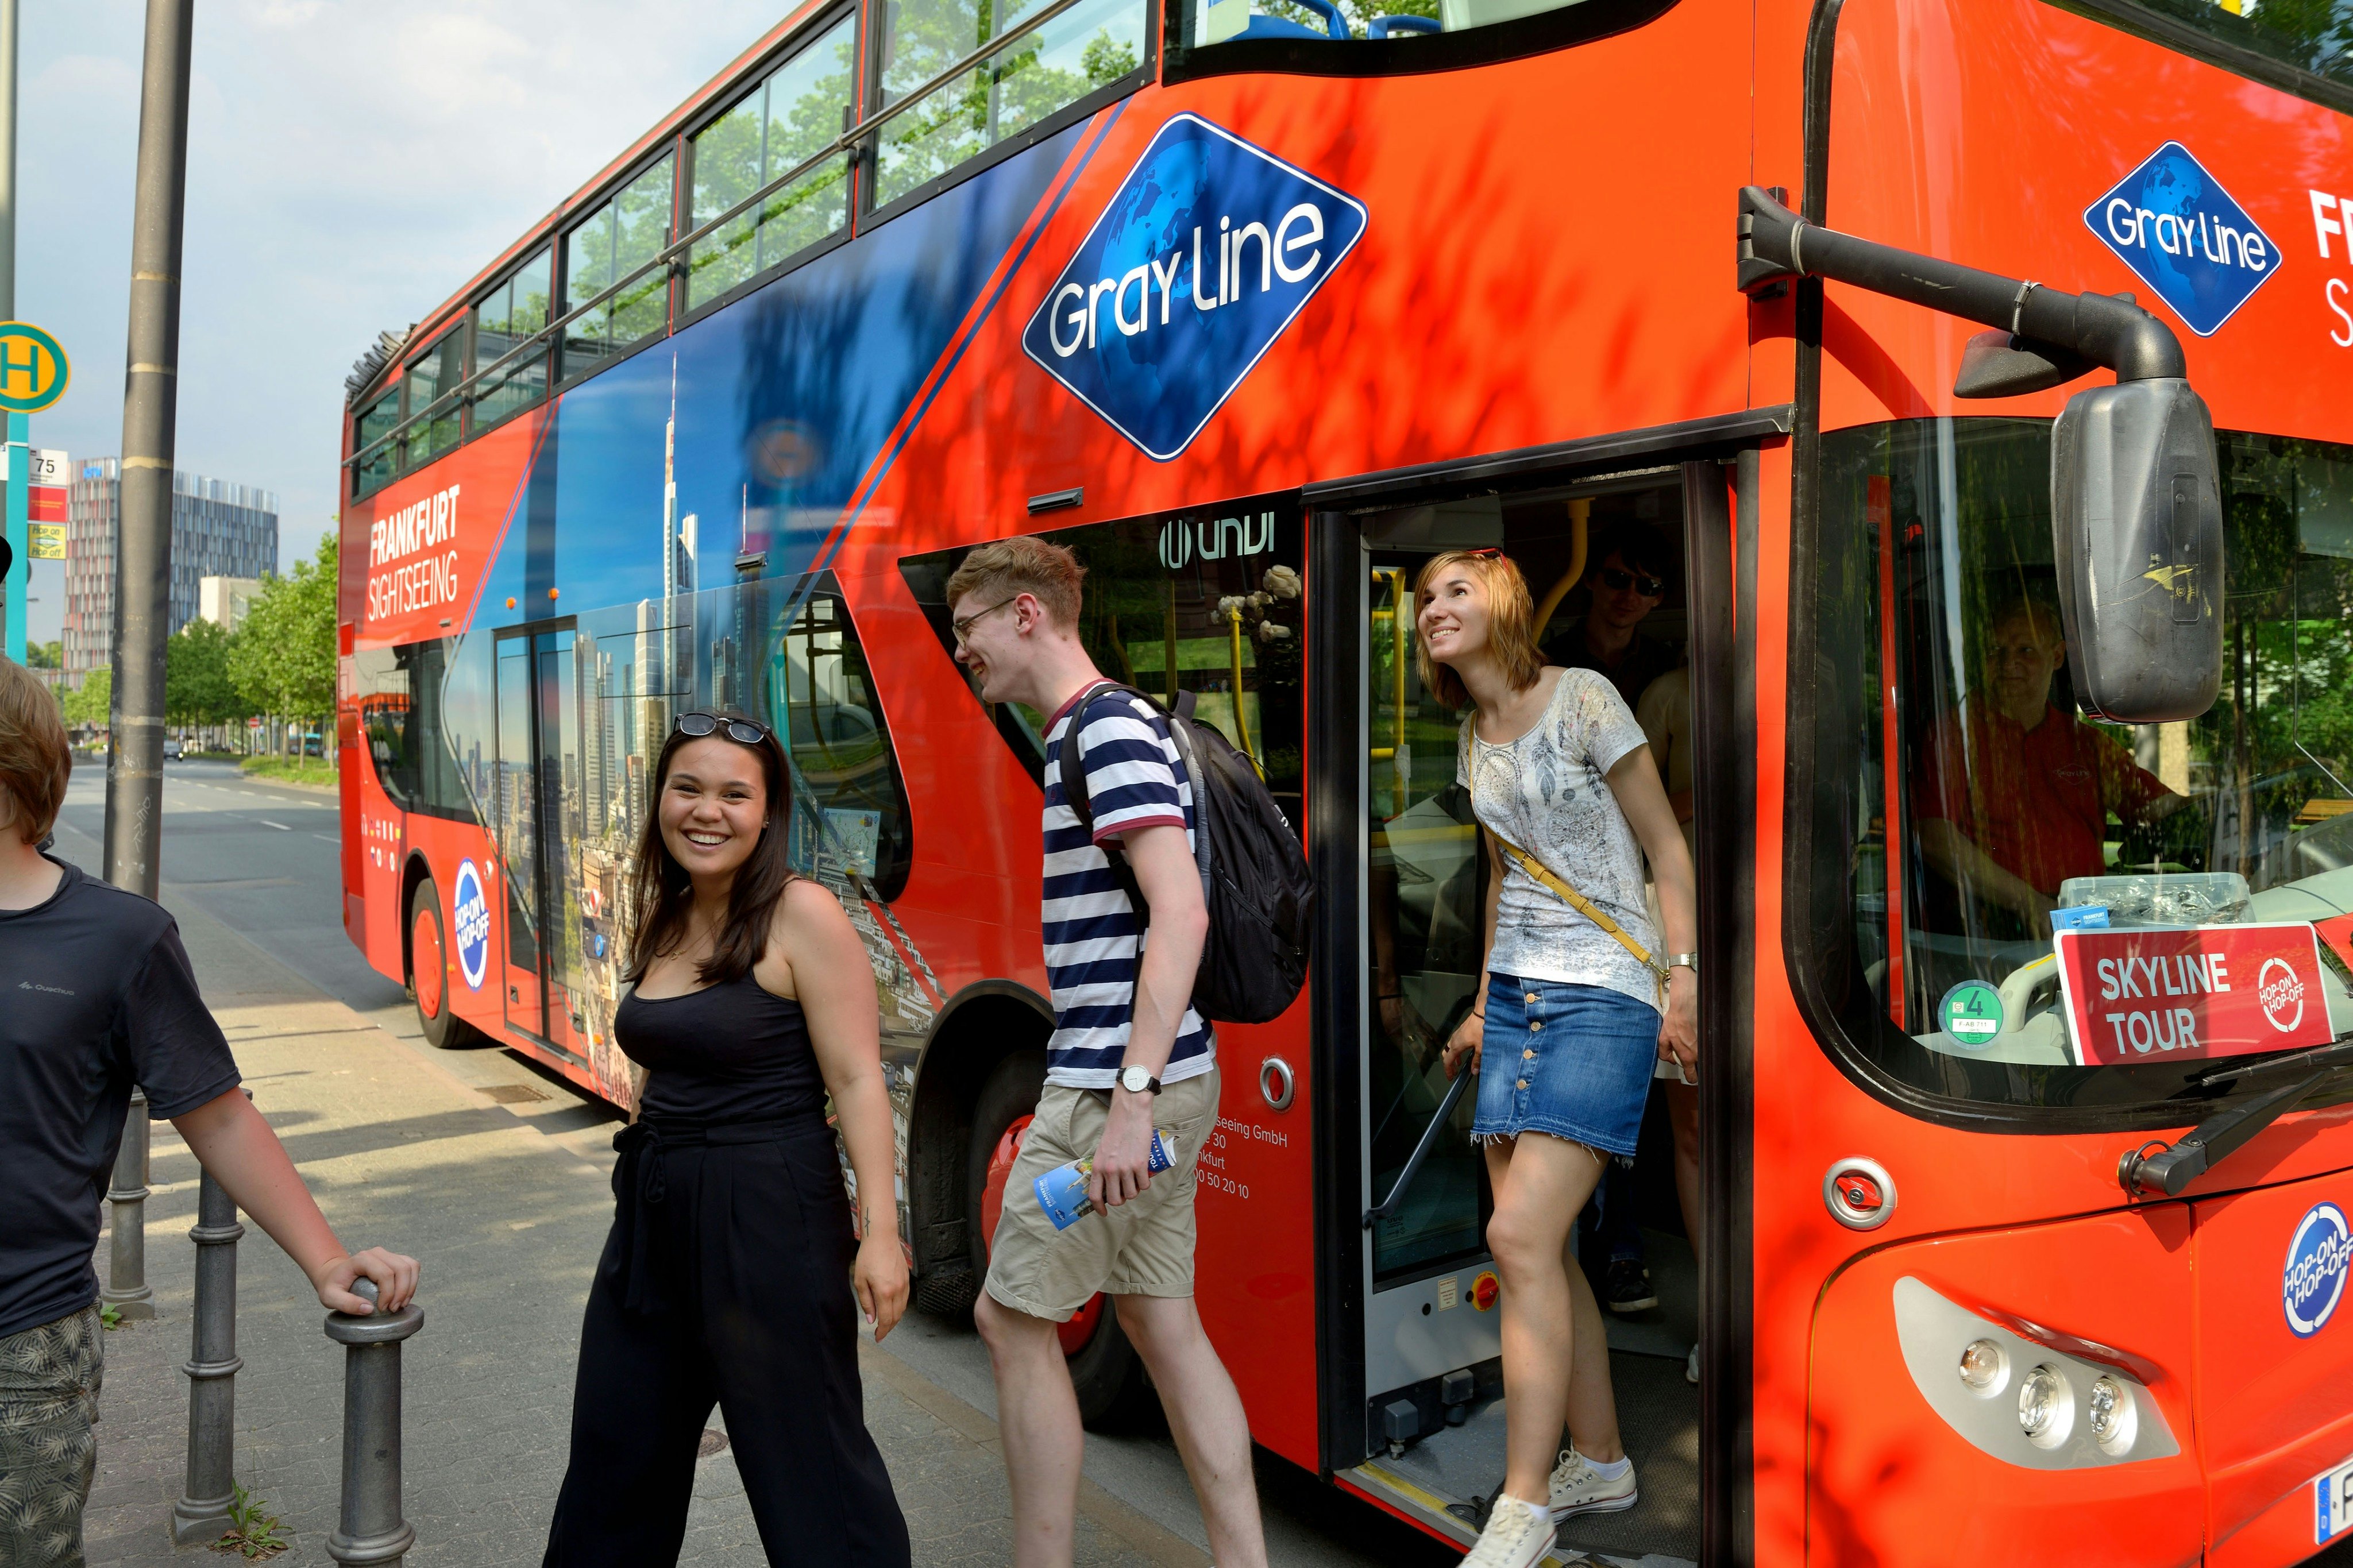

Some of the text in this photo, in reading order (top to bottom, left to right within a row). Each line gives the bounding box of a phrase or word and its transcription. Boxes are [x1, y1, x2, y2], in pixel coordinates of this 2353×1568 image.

[1, 342, 38, 392] H
[36, 458, 55, 473] 75
[369, 484, 460, 568] FRANKFURT
[368, 550, 458, 622] SIGHTSEEING
[455, 894, 480, 930] HOP-ON
[461, 912, 489, 951] HOP-OFF
[2097, 952, 2231, 1001] SKYLINE
[2259, 975, 2292, 1005] HOP-ON
[1966, 990, 1983, 1016] 4
[2269, 983, 2304, 1014] HOP-OFF
[2105, 1007, 2200, 1055] TOUR
[1213, 1133, 1226, 1149] 30
[1253, 1125, 1287, 1148] GmbH
[1039, 1180, 1052, 1207] FRANKFURT
[1208, 1172, 1220, 1188] 50
[1222, 1178, 1235, 1194] 20
[1238, 1184, 1249, 1199] 10
[2284, 1230, 2337, 1298] HOP-ON
[2295, 1234, 2353, 1309] HOP-OFF
